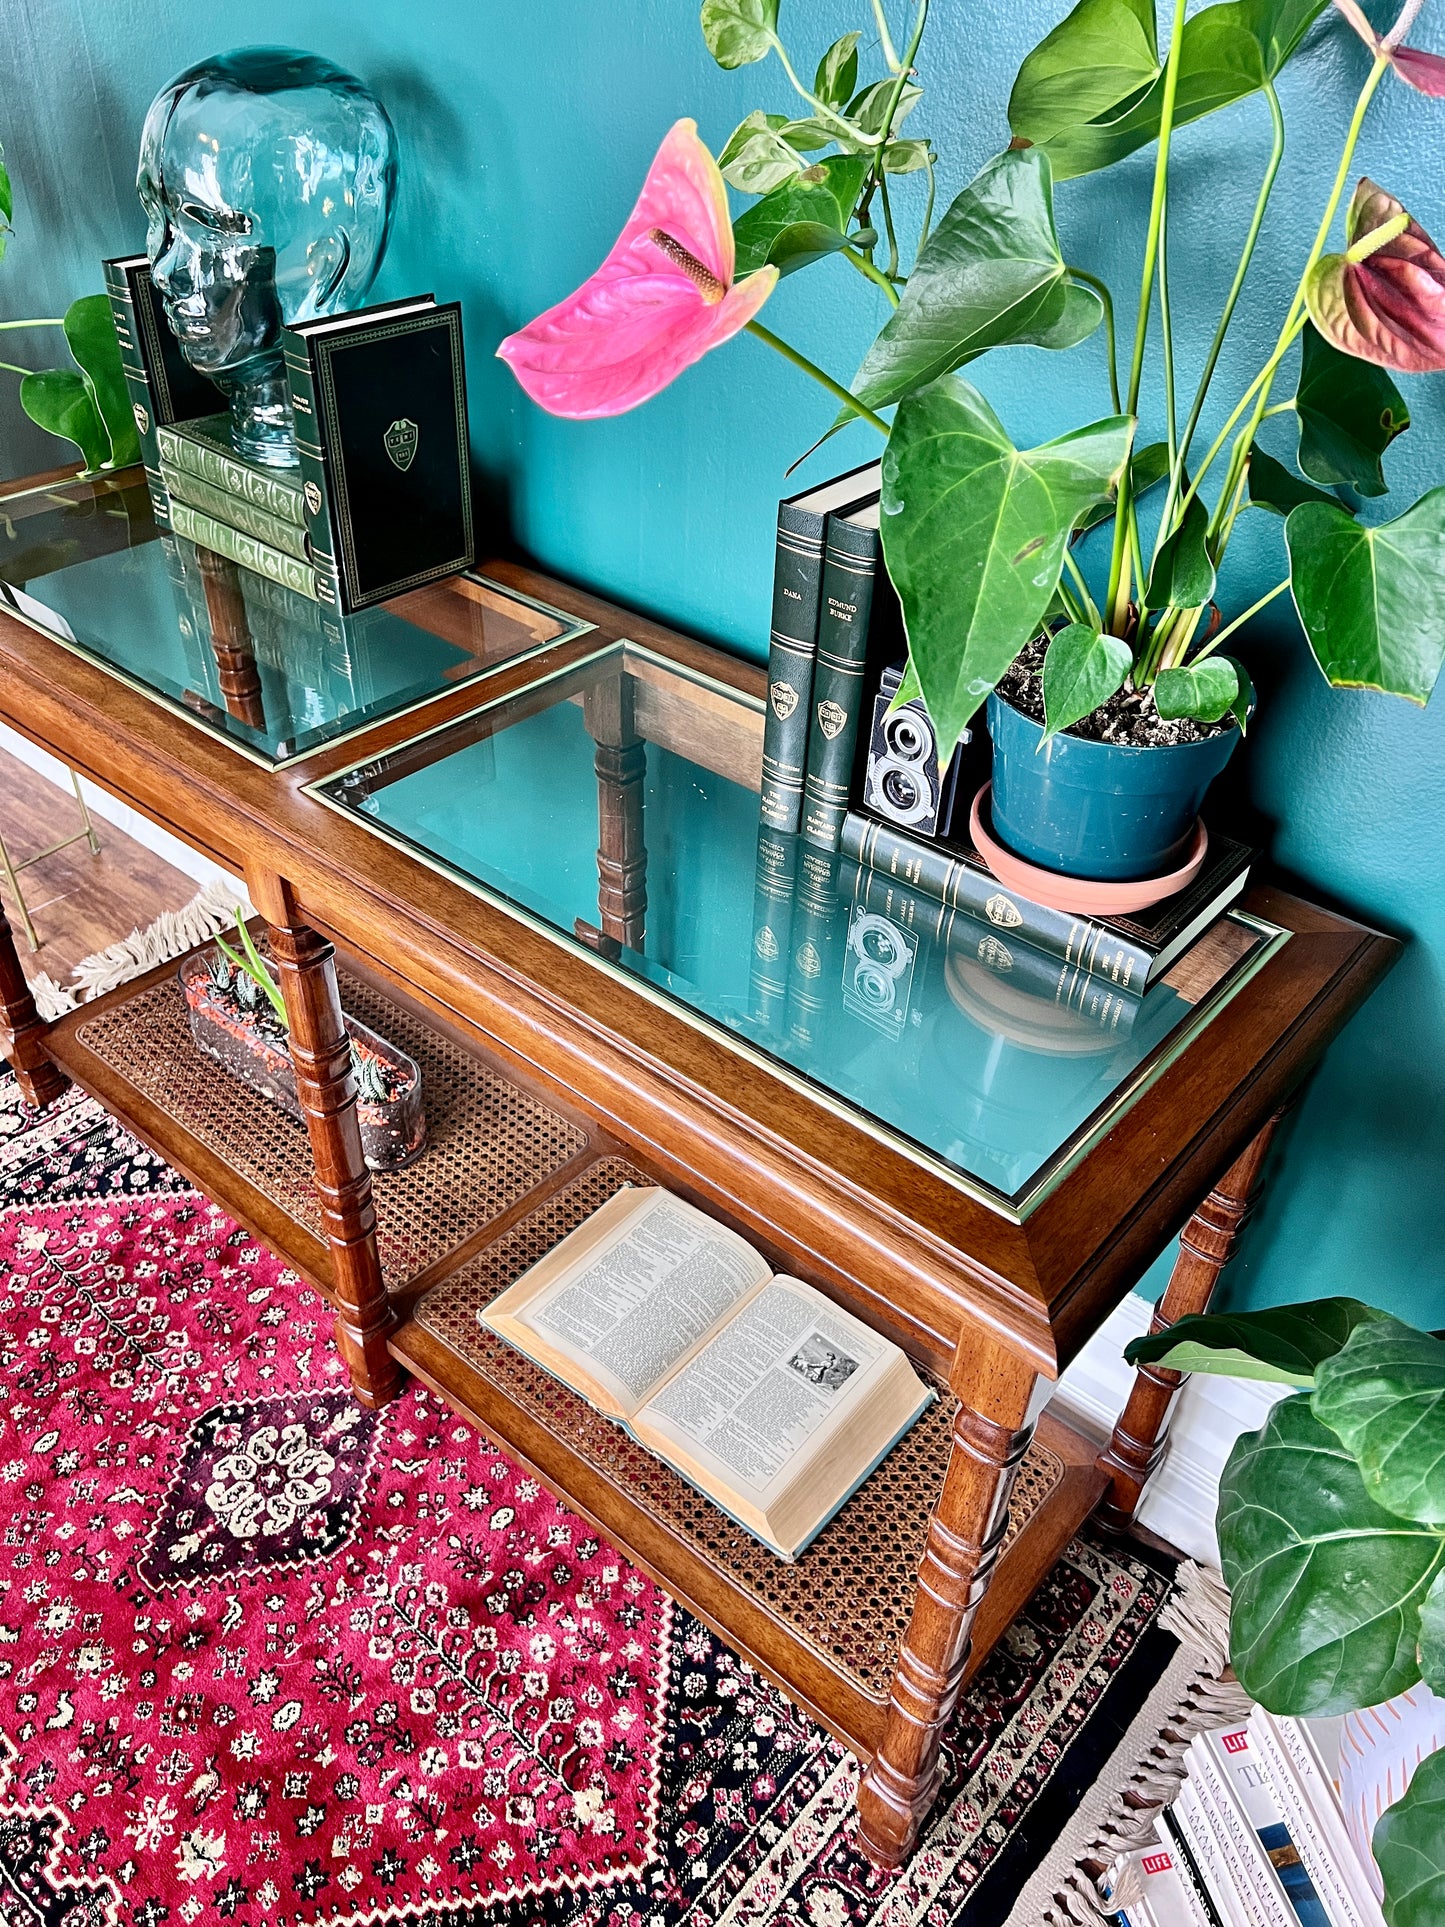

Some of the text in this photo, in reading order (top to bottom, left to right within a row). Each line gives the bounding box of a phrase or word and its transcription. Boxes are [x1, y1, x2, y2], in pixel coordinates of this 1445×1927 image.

[783, 588, 802, 601] DANA
[828, 597, 858, 613] EDMUND
[829, 608, 853, 622] BURKE
[1225, 1733, 1248, 1752] LIF
[1282, 1716, 1313, 1776] URKEY
[1203, 1762, 1221, 1792] THE
[1221, 1799, 1257, 1865] ANDEAN
[1263, 1735, 1304, 1814] HANDBOOK
[1304, 1822, 1317, 1841] OF
[1317, 1848, 1334, 1877] THE
[1193, 1776, 1209, 1803] THE
[1208, 1810, 1230, 1850] RIVER
[1229, 1856, 1253, 1900] PLATE
[1144, 1854, 1170, 1873] LIFE
[1174, 1838, 1197, 1882] INDEX
[1195, 1888, 1212, 1919] AND
